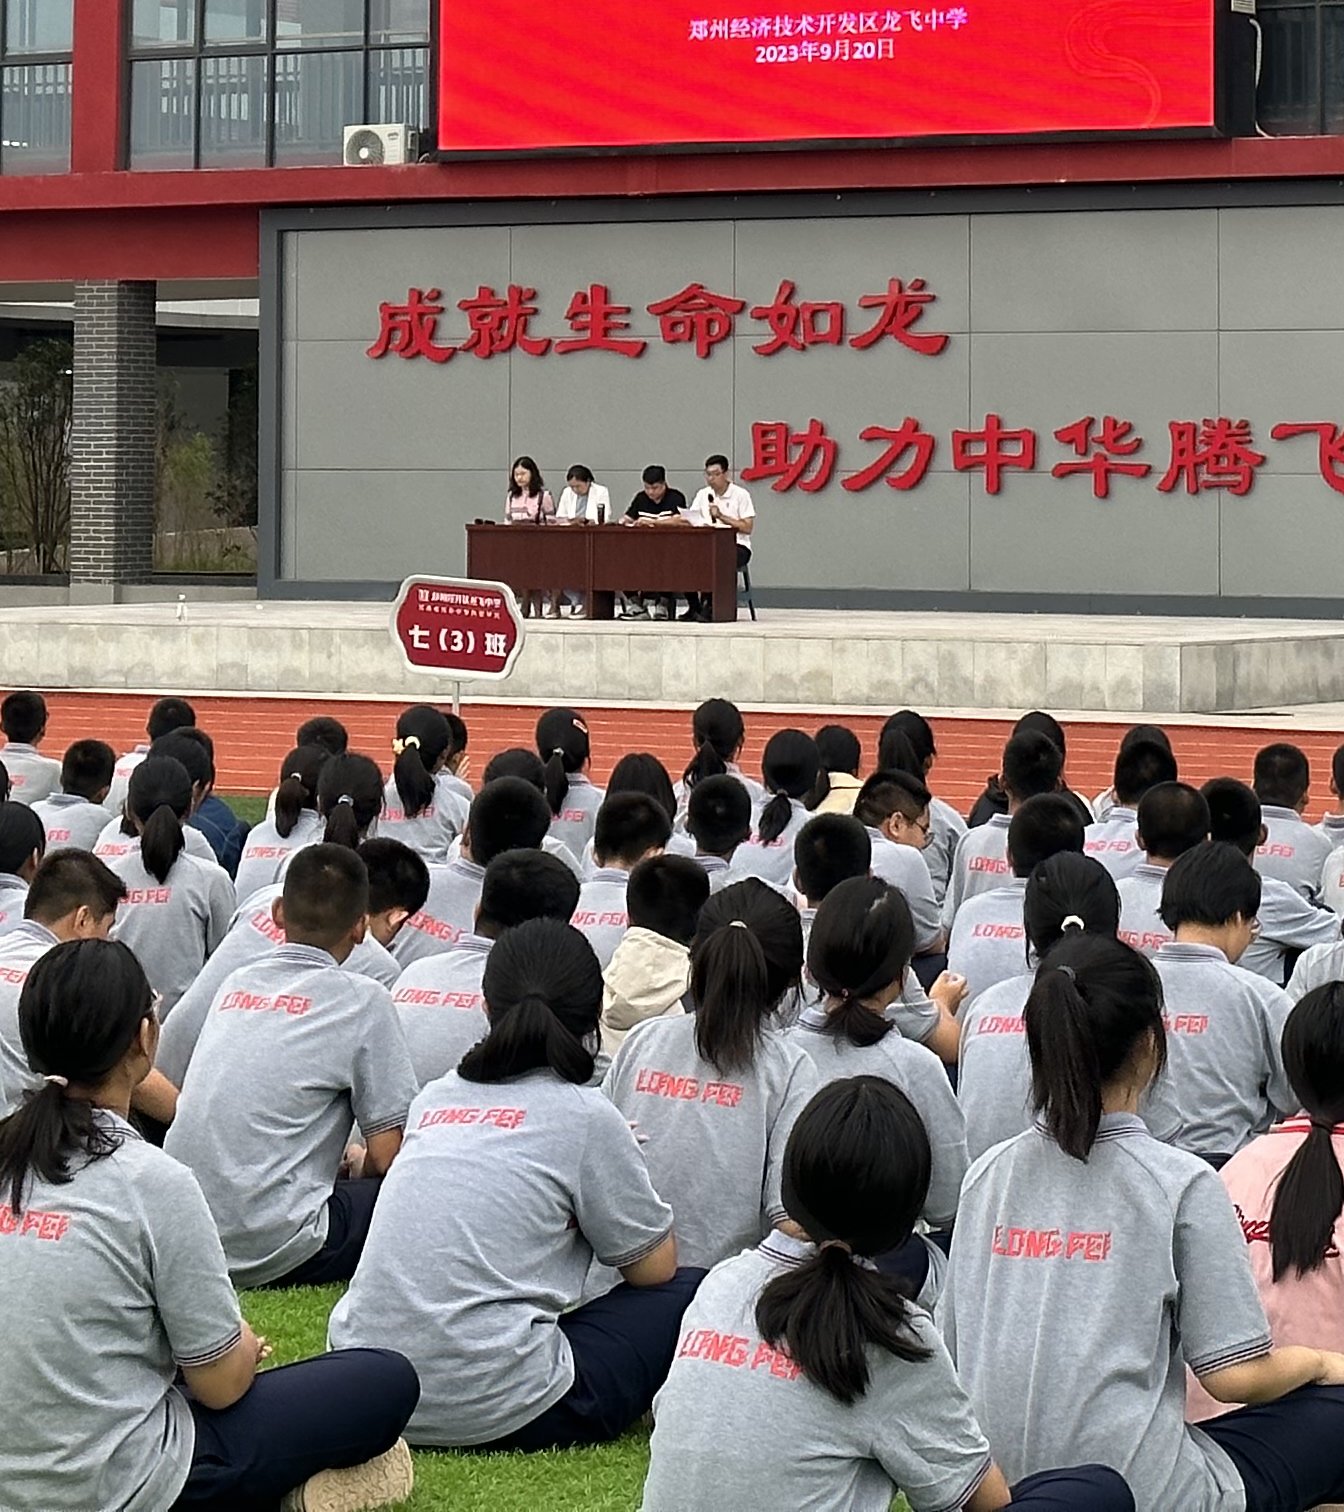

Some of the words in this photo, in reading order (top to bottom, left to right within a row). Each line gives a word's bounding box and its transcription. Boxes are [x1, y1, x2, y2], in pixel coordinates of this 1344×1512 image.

[688, 7, 968, 41] 郑州经济技术开发区龙飞中学
[756, 38, 894, 63] 2023年9月20日
[366, 278, 949, 364] 成就生命如龙
[220, 991, 274, 1011] LONG
[270, 994, 312, 1015] FEI
[1174, 1014, 1210, 1035] FEI
[636, 1067, 701, 1101] LONG
[700, 1080, 744, 1109] FEI
[418, 1107, 480, 1130] LONG
[478, 1108, 527, 1130] FEI
[19, 1210, 71, 1241] FEI
[991, 1224, 1063, 1259] LONG
[1064, 1230, 1113, 1263] FEI
[677, 1328, 751, 1368] LONG
